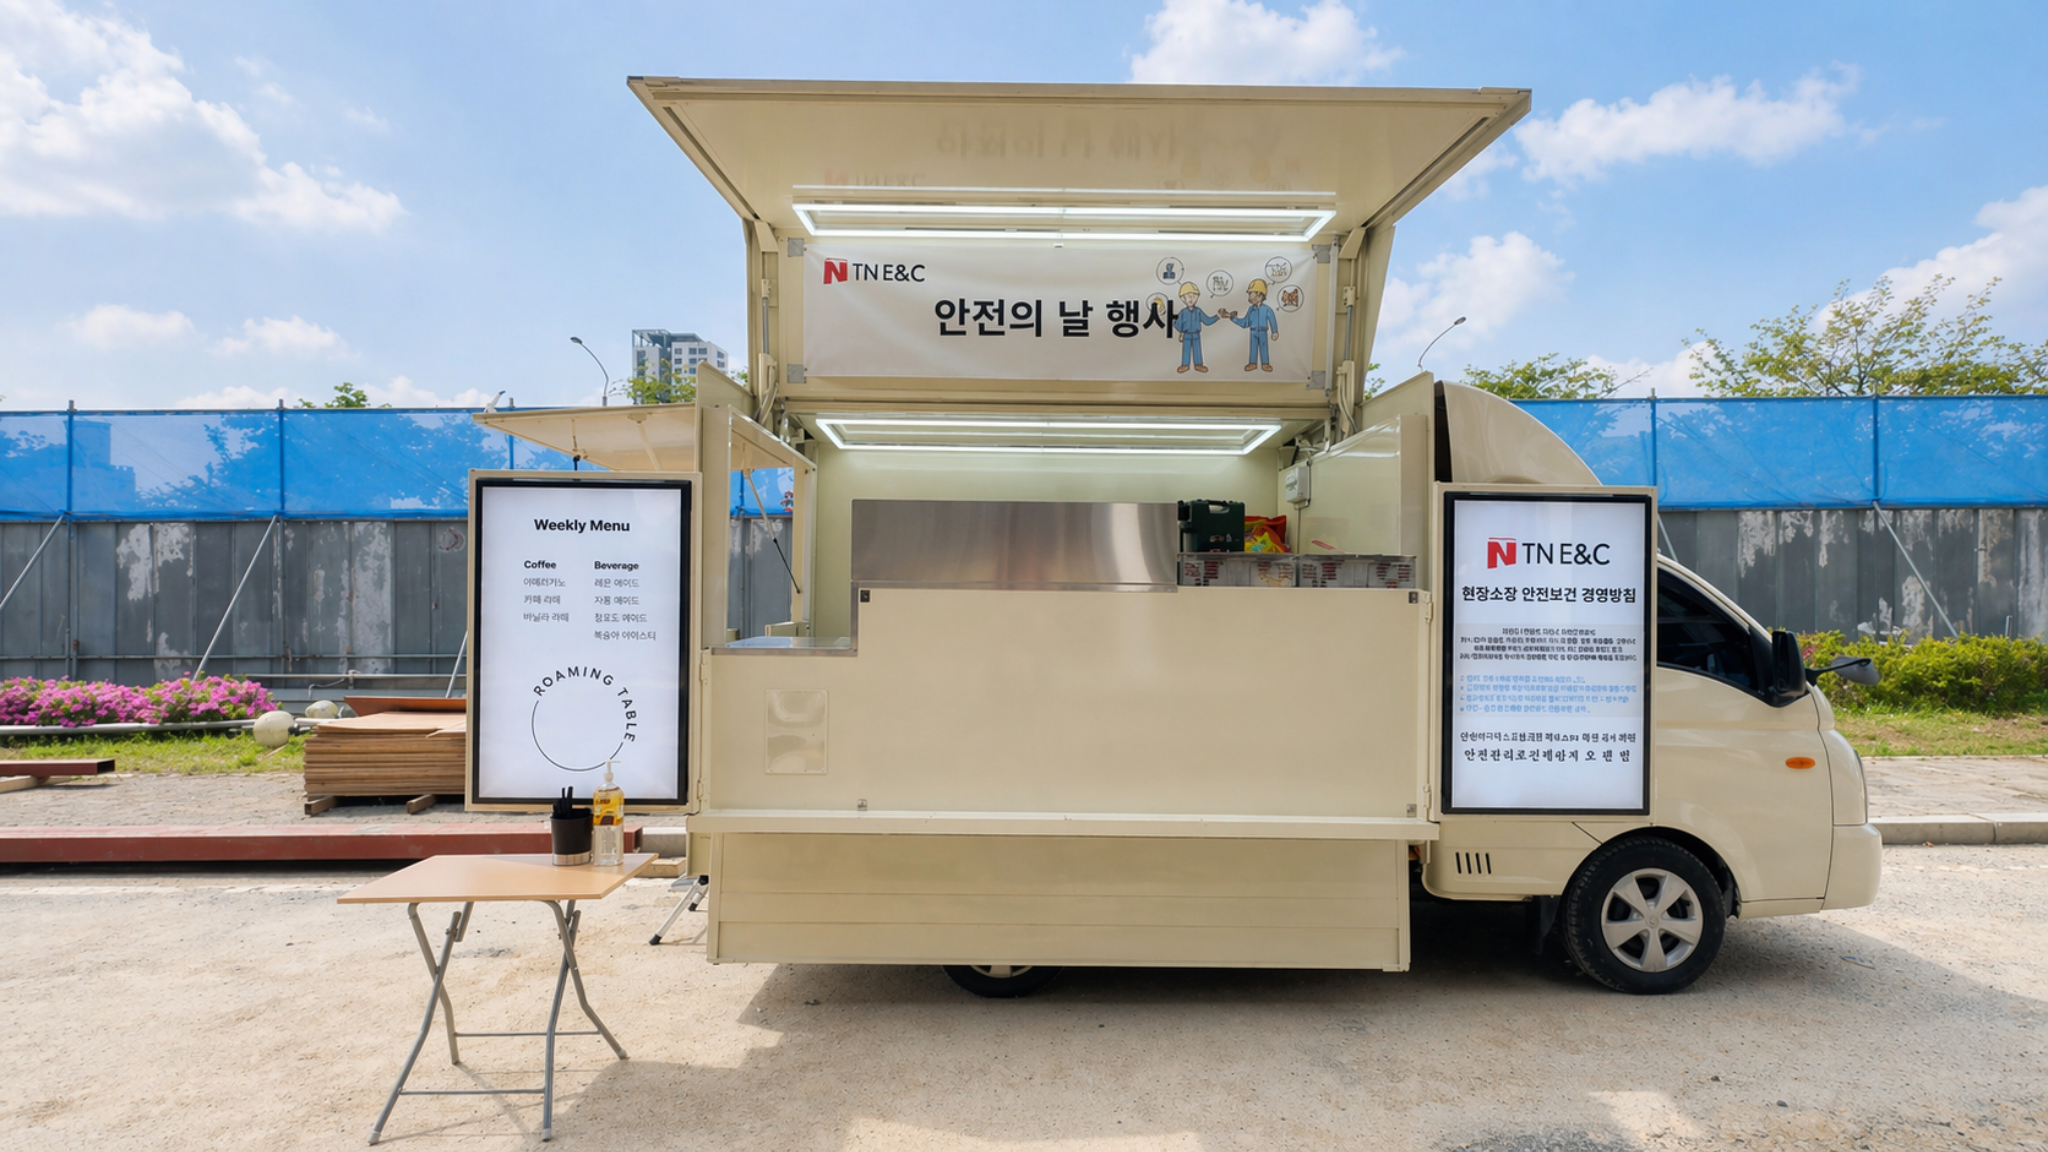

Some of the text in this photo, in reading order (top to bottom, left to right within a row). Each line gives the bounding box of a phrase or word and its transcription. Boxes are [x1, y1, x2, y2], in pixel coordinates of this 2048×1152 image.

[934, 298, 1178, 339] 안전의 날 행사
[533, 518, 630, 534] Weekly Menu
[523, 559, 557, 570] Coffee
[593, 560, 640, 572] Beverage
[1461, 585, 1637, 604] 현장소장 안전보건 경영방침
[533, 665, 638, 742] ROAMING TABLE
